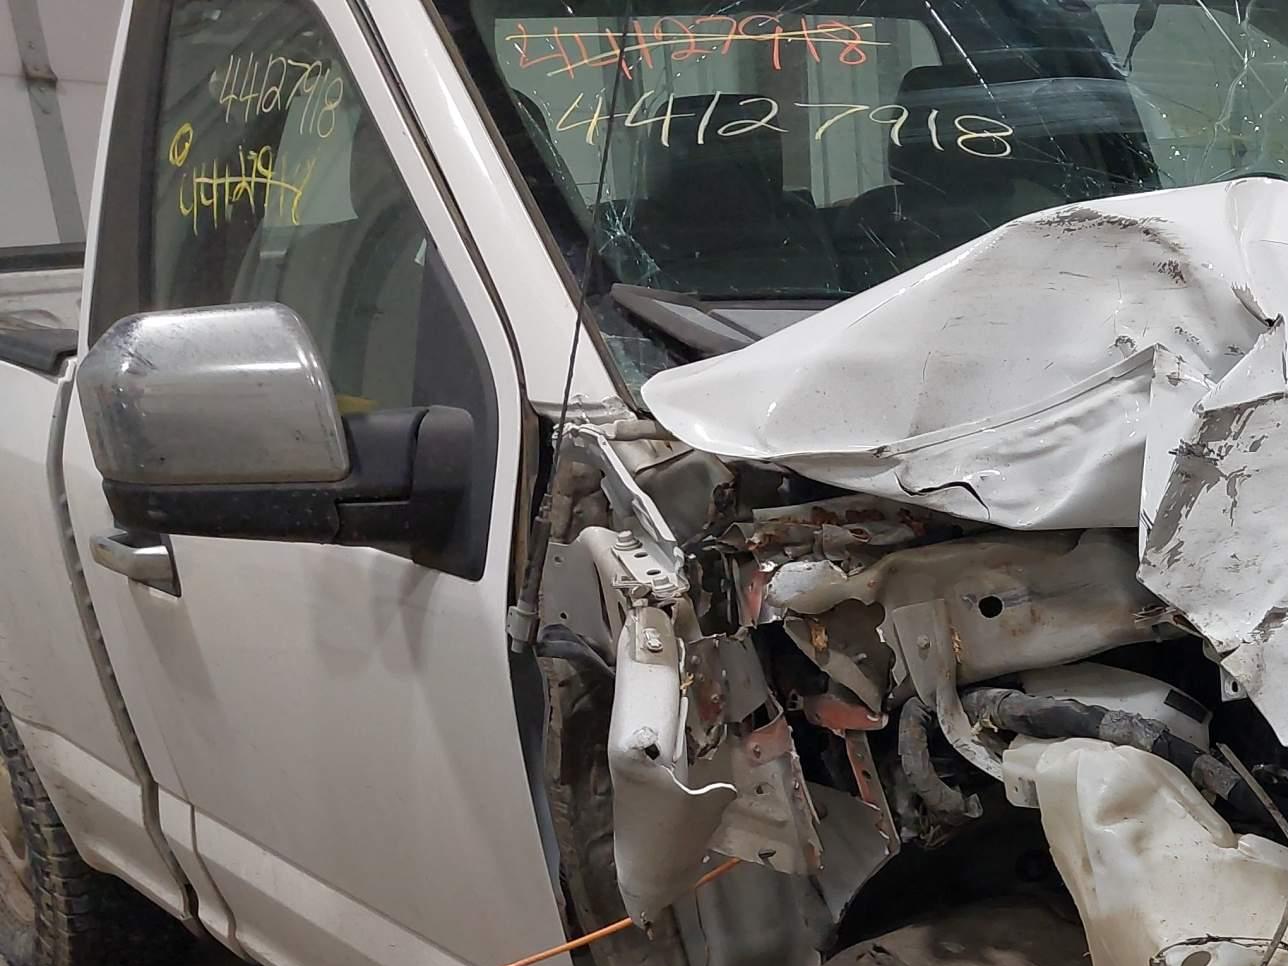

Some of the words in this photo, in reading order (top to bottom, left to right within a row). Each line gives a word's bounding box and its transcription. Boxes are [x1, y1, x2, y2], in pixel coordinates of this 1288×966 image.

[515, 14, 868, 79] 44127918
[219, 51, 344, 138] 44127918
[555, 89, 1015, 158] 44127918
